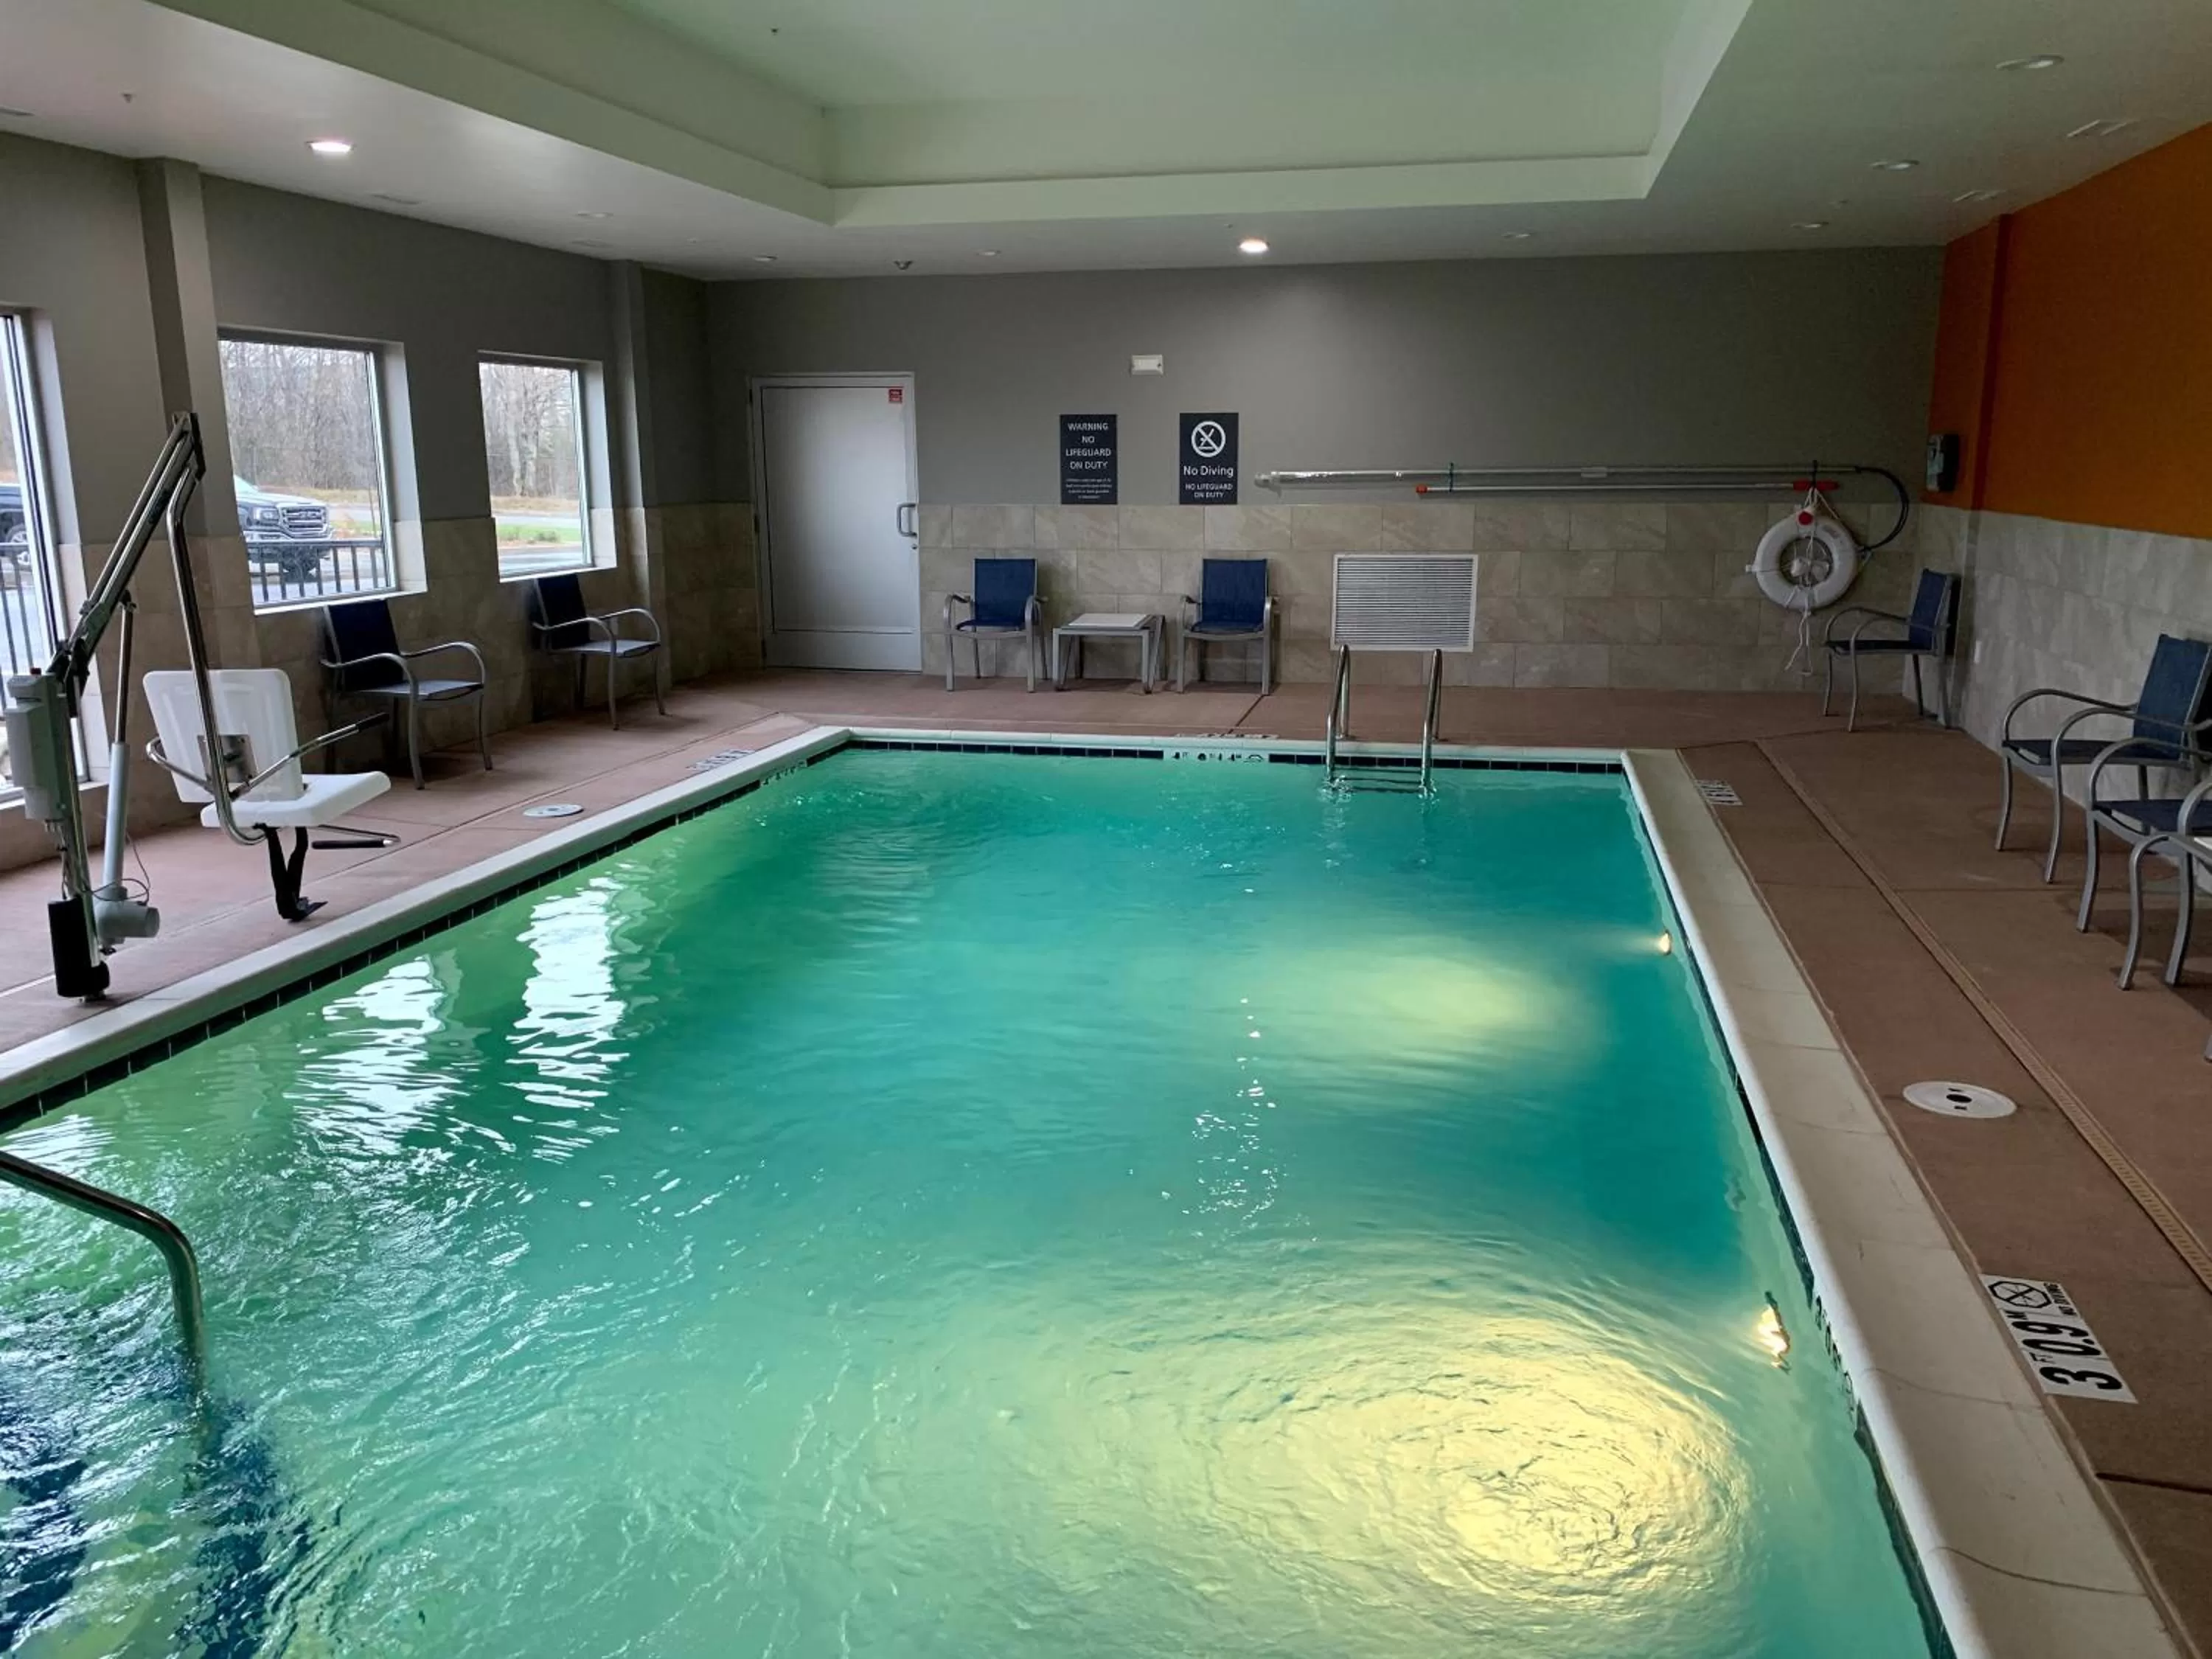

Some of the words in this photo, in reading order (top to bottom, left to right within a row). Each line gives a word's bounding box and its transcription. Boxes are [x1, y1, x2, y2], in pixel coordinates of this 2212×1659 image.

[1067, 422, 1109, 431] WARNING
[1065, 448, 1111, 456] LIFEGUARD
[1070, 461, 1082, 469] ON
[1085, 461, 1108, 469] DUTY
[1183, 465, 1198, 476] No
[1200, 465, 1234, 478] Diving
[2011, 1321, 2101, 1356] 0.9
[2039, 1366, 2123, 1391] 3
